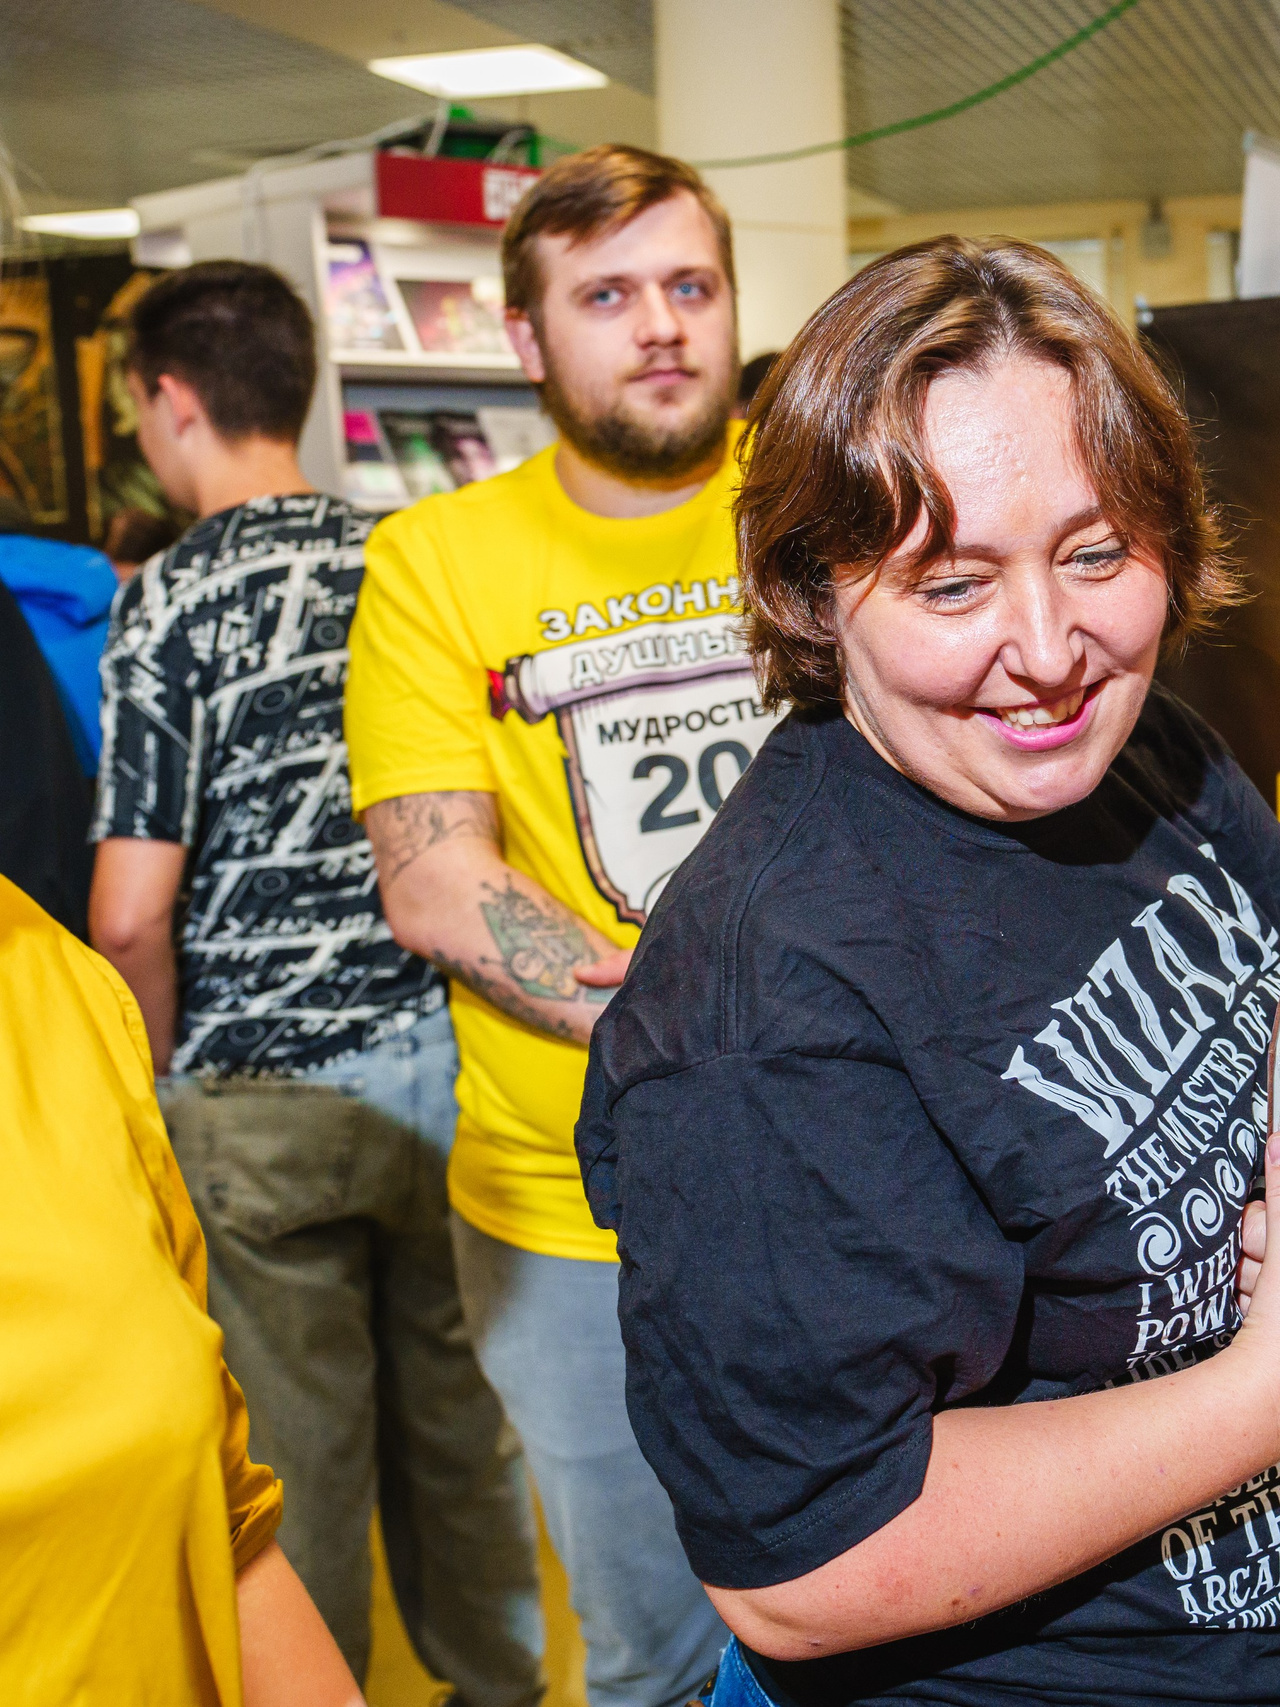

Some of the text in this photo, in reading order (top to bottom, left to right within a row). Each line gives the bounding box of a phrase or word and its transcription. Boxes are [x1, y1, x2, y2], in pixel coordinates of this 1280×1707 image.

[539, 577, 740, 642] ЗАКОНН
[570, 628, 742, 691] ДУШНЫ
[632, 740, 753, 834] 20
[1104, 990, 1273, 1216] THE MASTER OF
[1136, 1218, 1242, 1316] I WIEL
[1133, 1274, 1244, 1355] POW
[1161, 1511, 1217, 1581] OF
